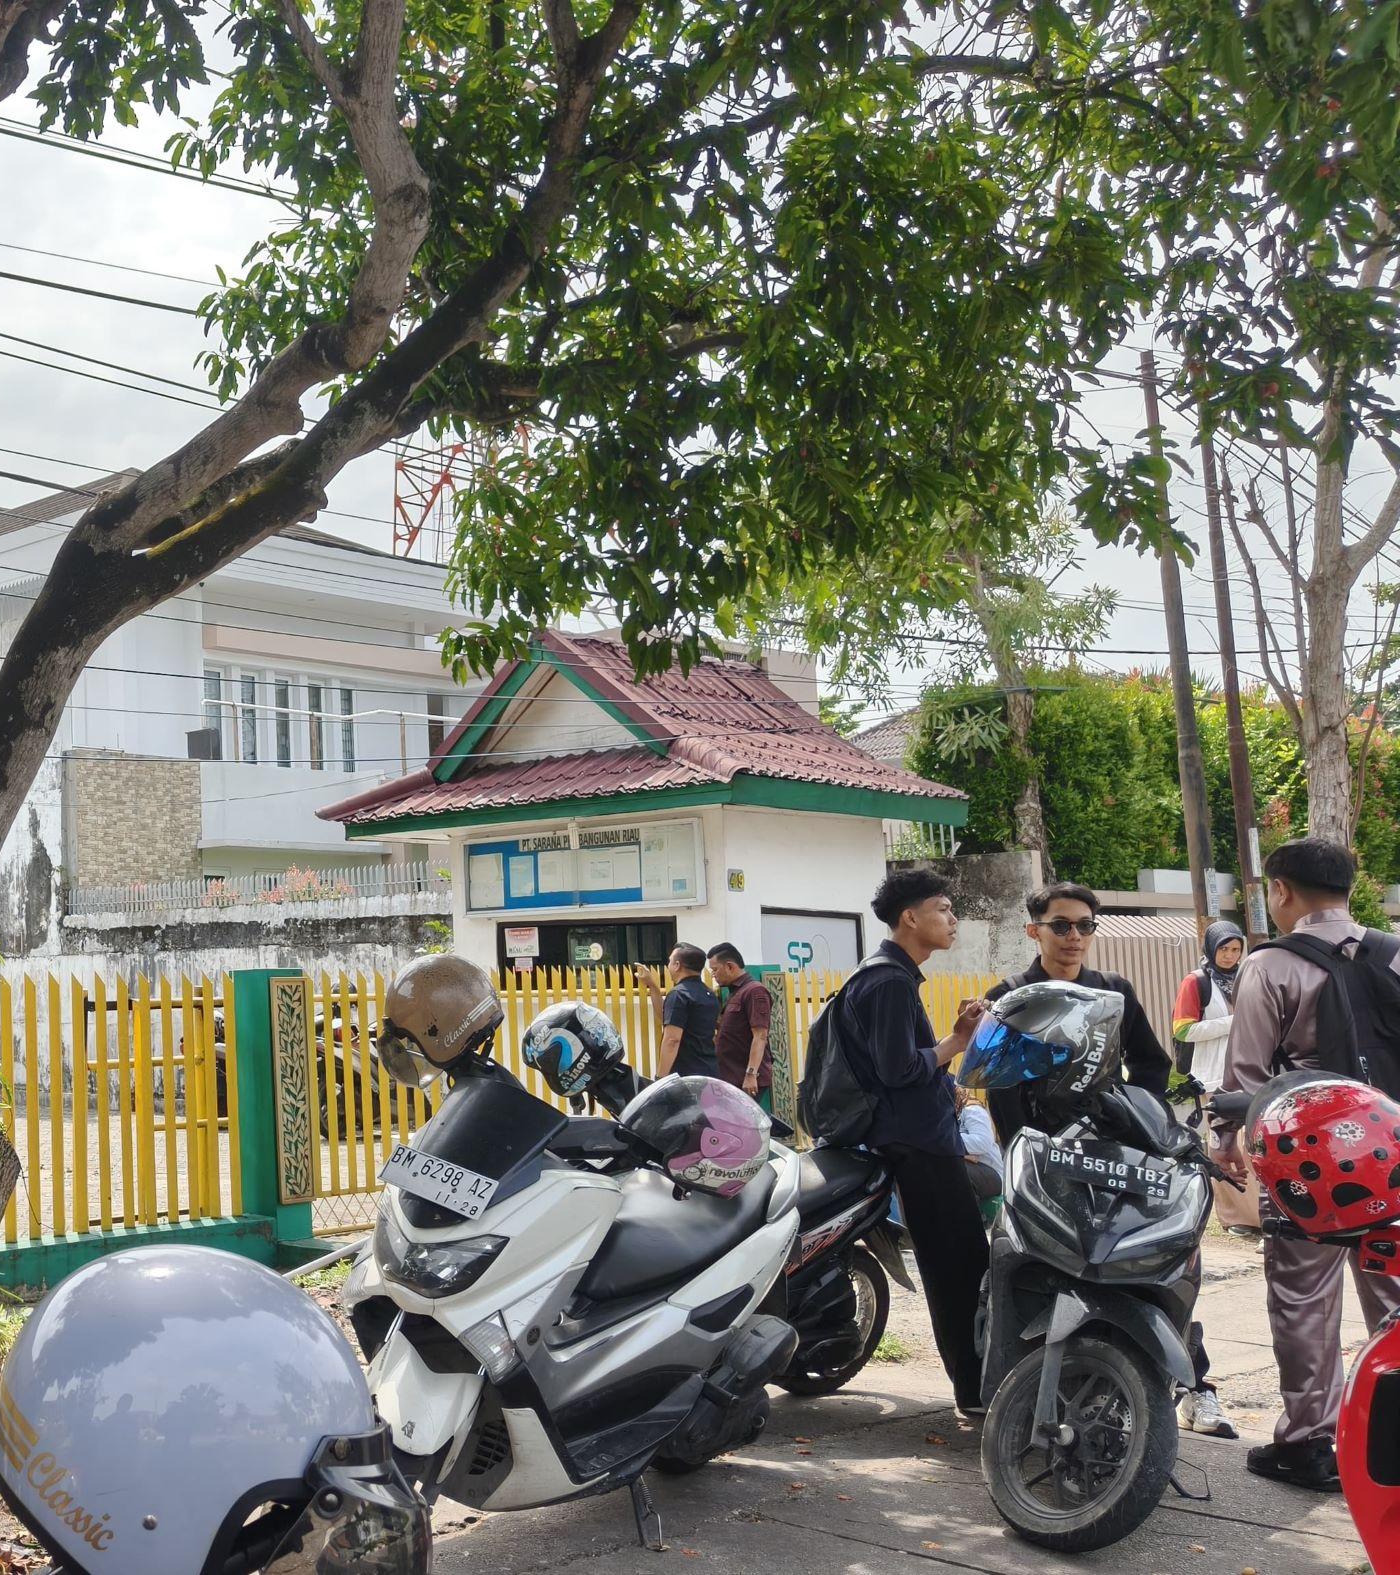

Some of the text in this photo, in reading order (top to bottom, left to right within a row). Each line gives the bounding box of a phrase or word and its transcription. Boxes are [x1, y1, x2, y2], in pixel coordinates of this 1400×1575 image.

[533, 834, 561, 849] SARANA
[563, 829, 621, 849] PBANGUNAN
[622, 828, 640, 842] RIAU
[443, 1017, 471, 1048] Classic
[1070, 1031, 1107, 1092] Red Bull
[391, 1146, 493, 1199] BM 6298 AZ
[1050, 1149, 1169, 1186] BM 5510 TBZ
[1108, 1179, 1165, 1197] 05 29
[27, 1452, 115, 1551] Classic
